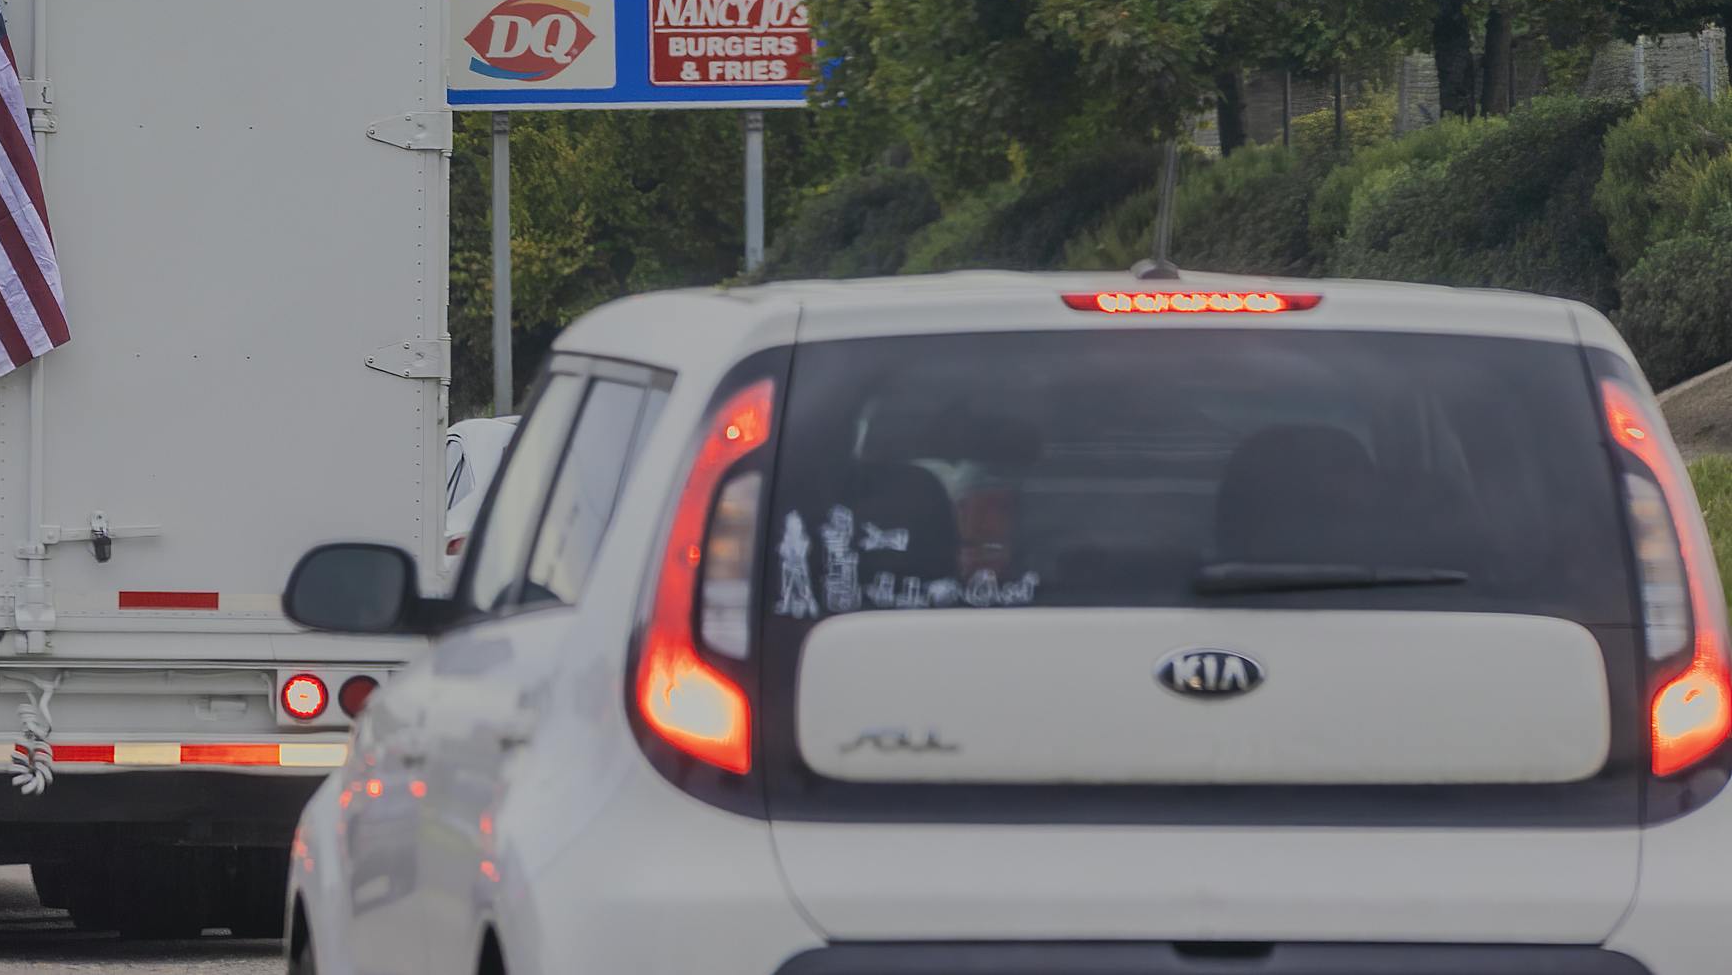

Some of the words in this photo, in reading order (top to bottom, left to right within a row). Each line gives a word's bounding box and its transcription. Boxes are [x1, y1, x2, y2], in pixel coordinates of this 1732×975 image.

[485, 14, 578, 65] DQ
[669, 36, 797, 57] BURGERS
[680, 61, 700, 81] &
[708, 60, 787, 81] FRIES
[1173, 655, 1248, 691] KIA
